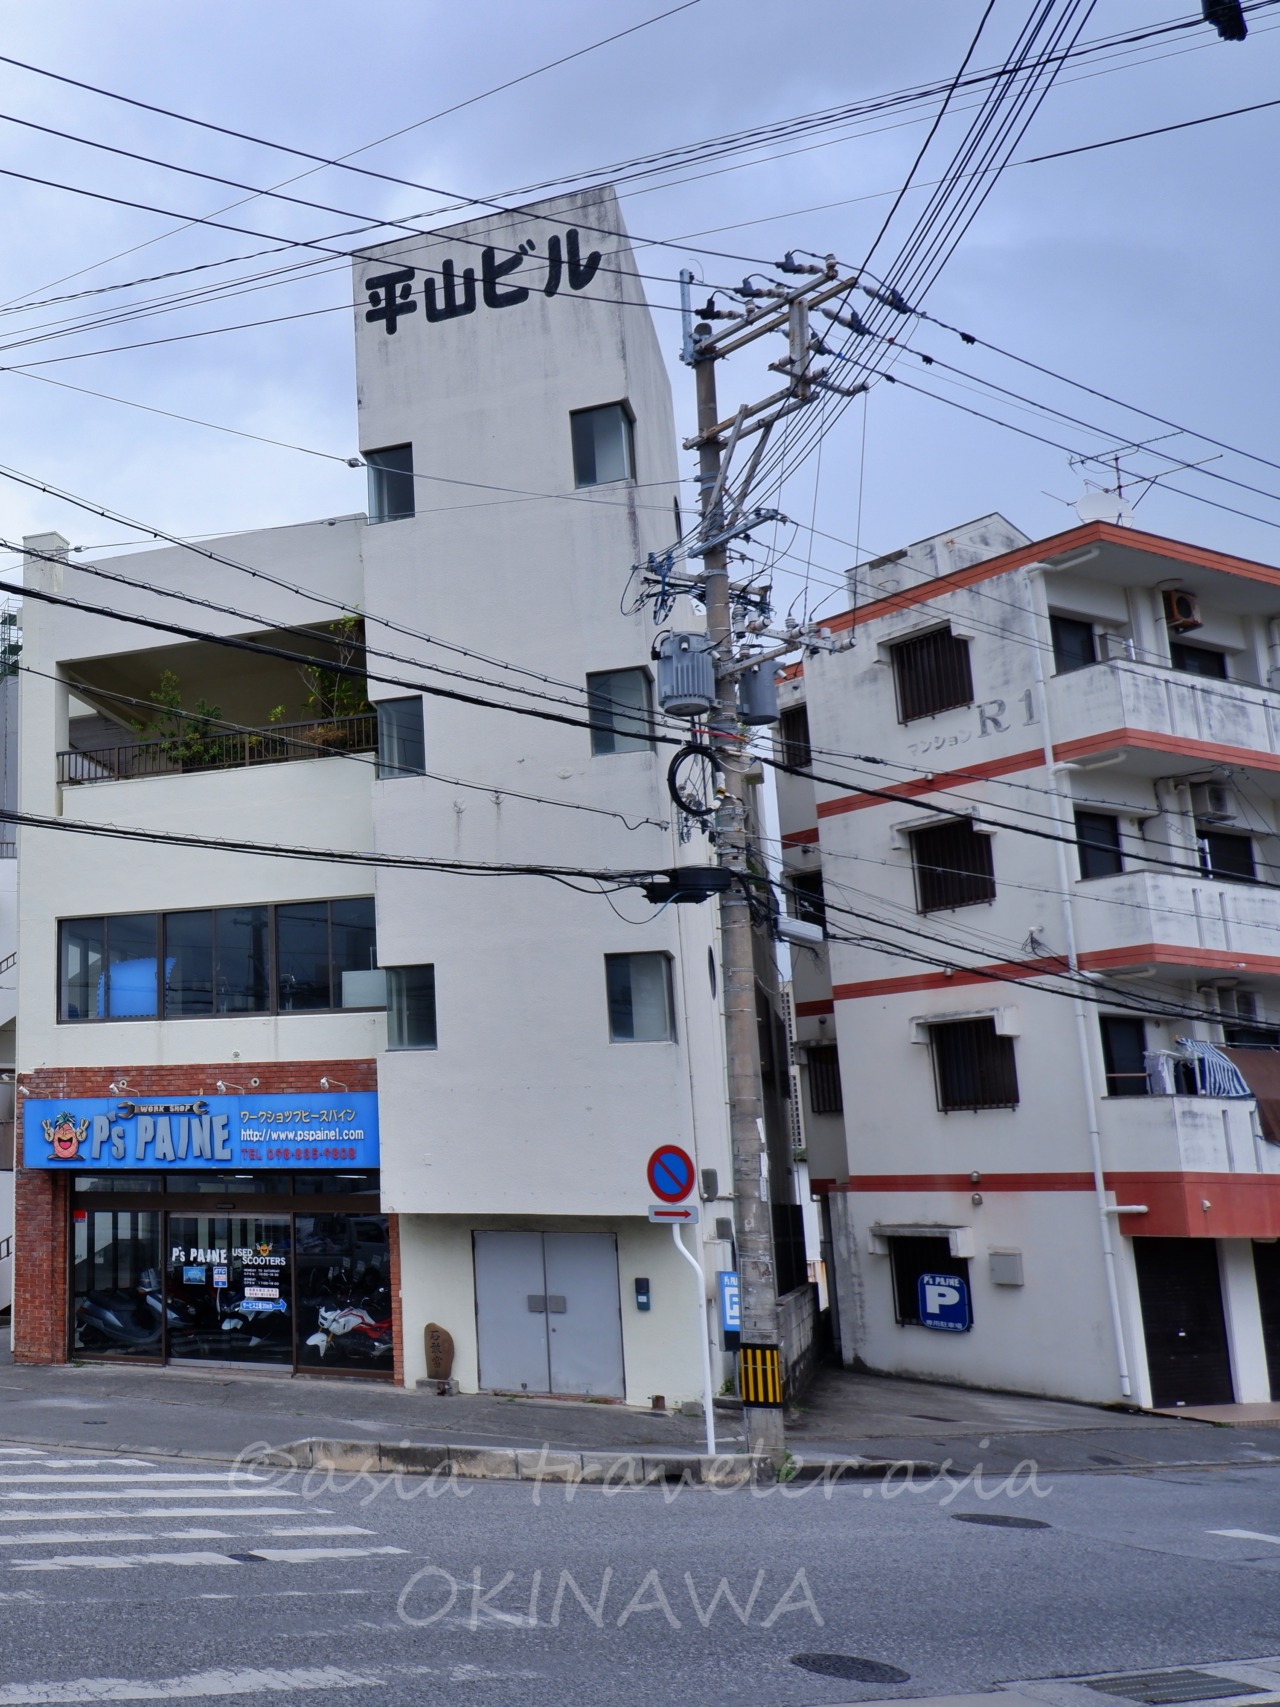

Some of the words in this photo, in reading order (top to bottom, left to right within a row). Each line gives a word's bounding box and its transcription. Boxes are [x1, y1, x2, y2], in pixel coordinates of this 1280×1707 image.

[365, 228, 602, 336] 平山ビル
[907, 730, 972, 757] マンション
[135, 1114, 232, 1162] PAINE
[241, 1148, 262, 1160] TEL
[189, 1248, 228, 1263] PAINE
[232, 1248, 253, 1257] USED
[242, 1256, 286, 1266] SCOOTERS
[925, 1284, 960, 1314] P
